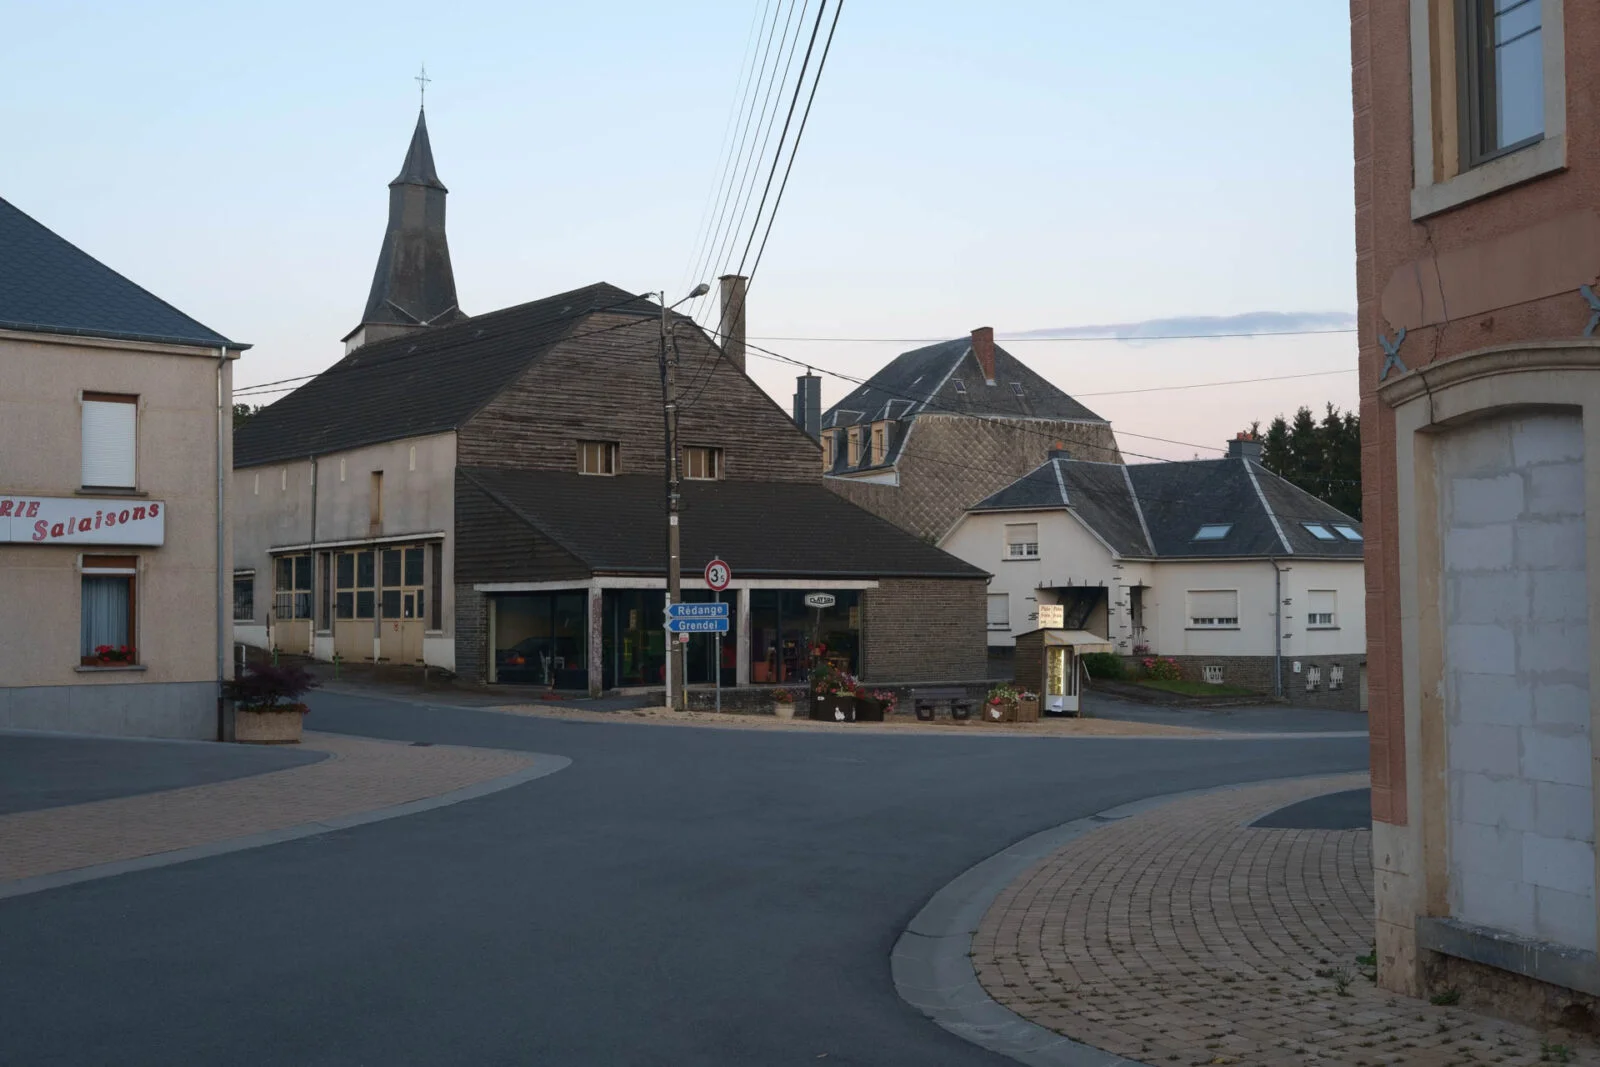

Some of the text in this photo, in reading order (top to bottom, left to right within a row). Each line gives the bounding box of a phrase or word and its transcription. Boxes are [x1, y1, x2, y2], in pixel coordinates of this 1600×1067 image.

[0, 500, 40, 518] RIE
[32, 503, 159, 541] Salaisons
[710, 568, 719, 583] 3
[678, 621, 718, 630] Grendel
